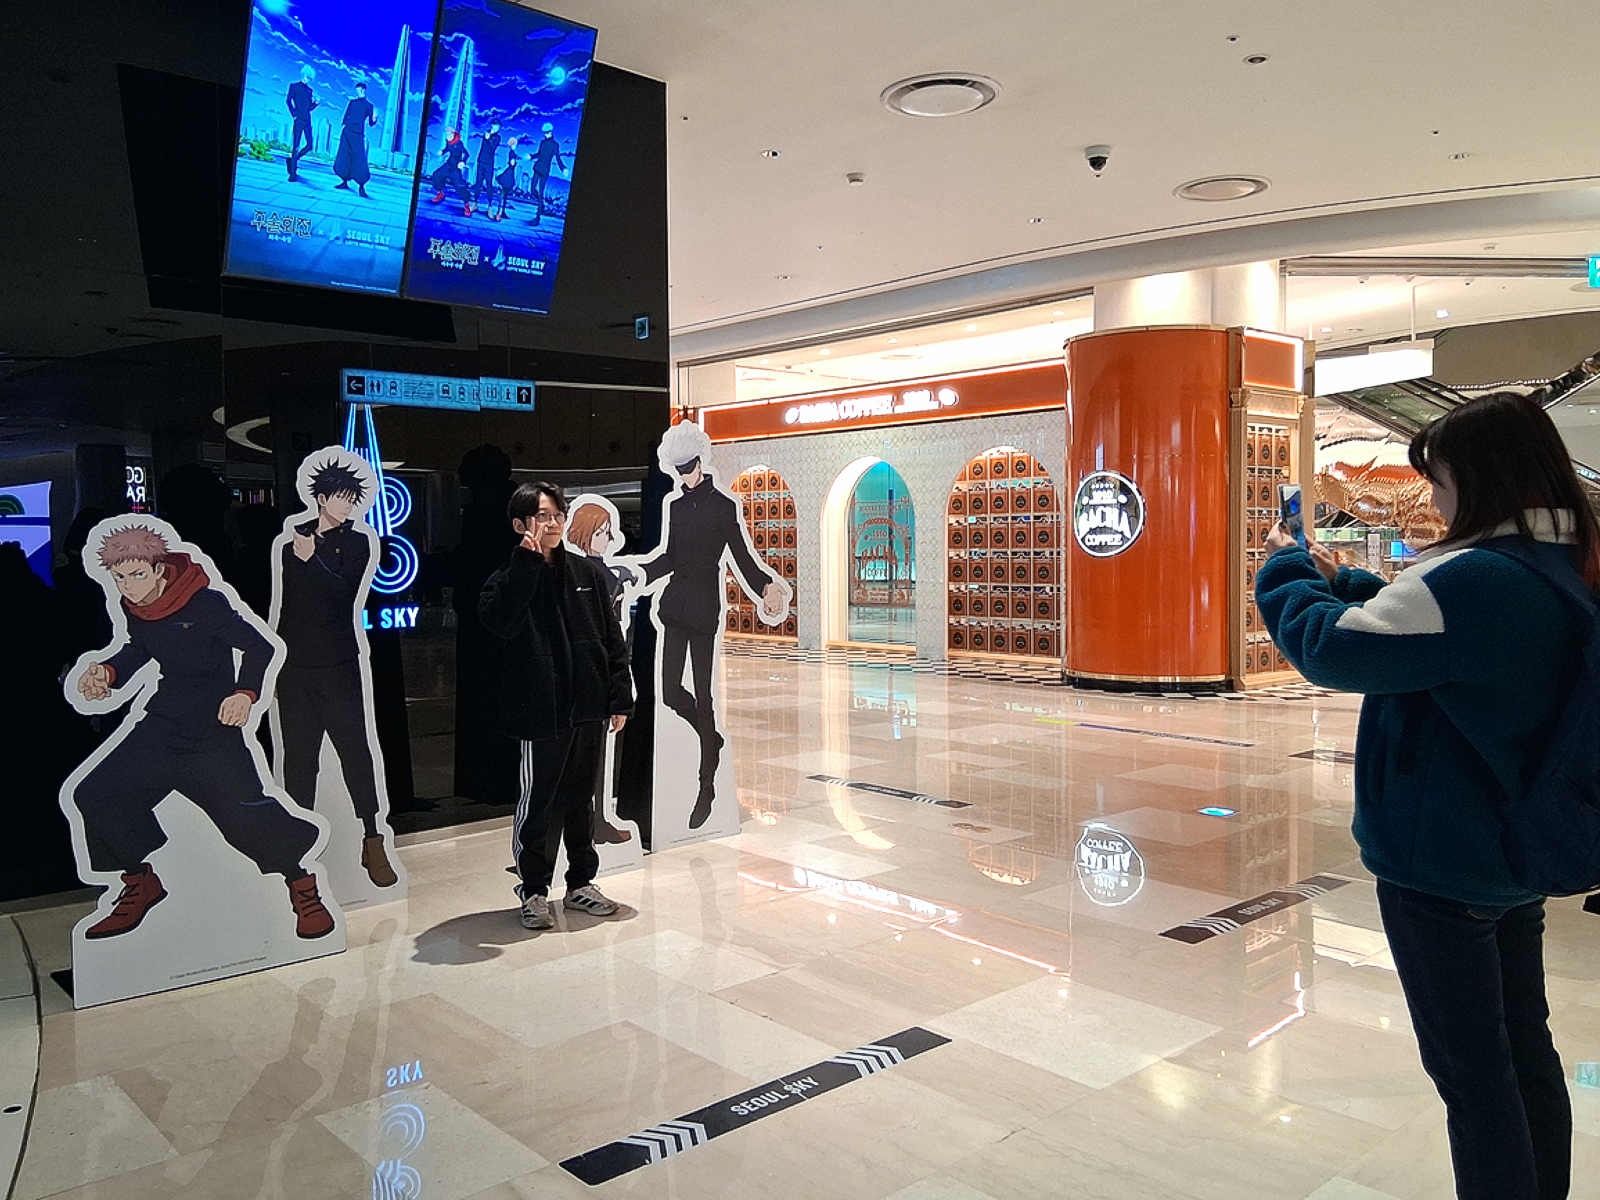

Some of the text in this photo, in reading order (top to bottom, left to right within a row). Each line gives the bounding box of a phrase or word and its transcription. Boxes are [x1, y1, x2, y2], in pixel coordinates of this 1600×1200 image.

[346, 228, 391, 245] SEOUL SKY
[507, 256, 546, 270] SEOUL SKY
[380, 606, 420, 629] SKY
[730, 1075, 820, 1116] SEOUL SKY
